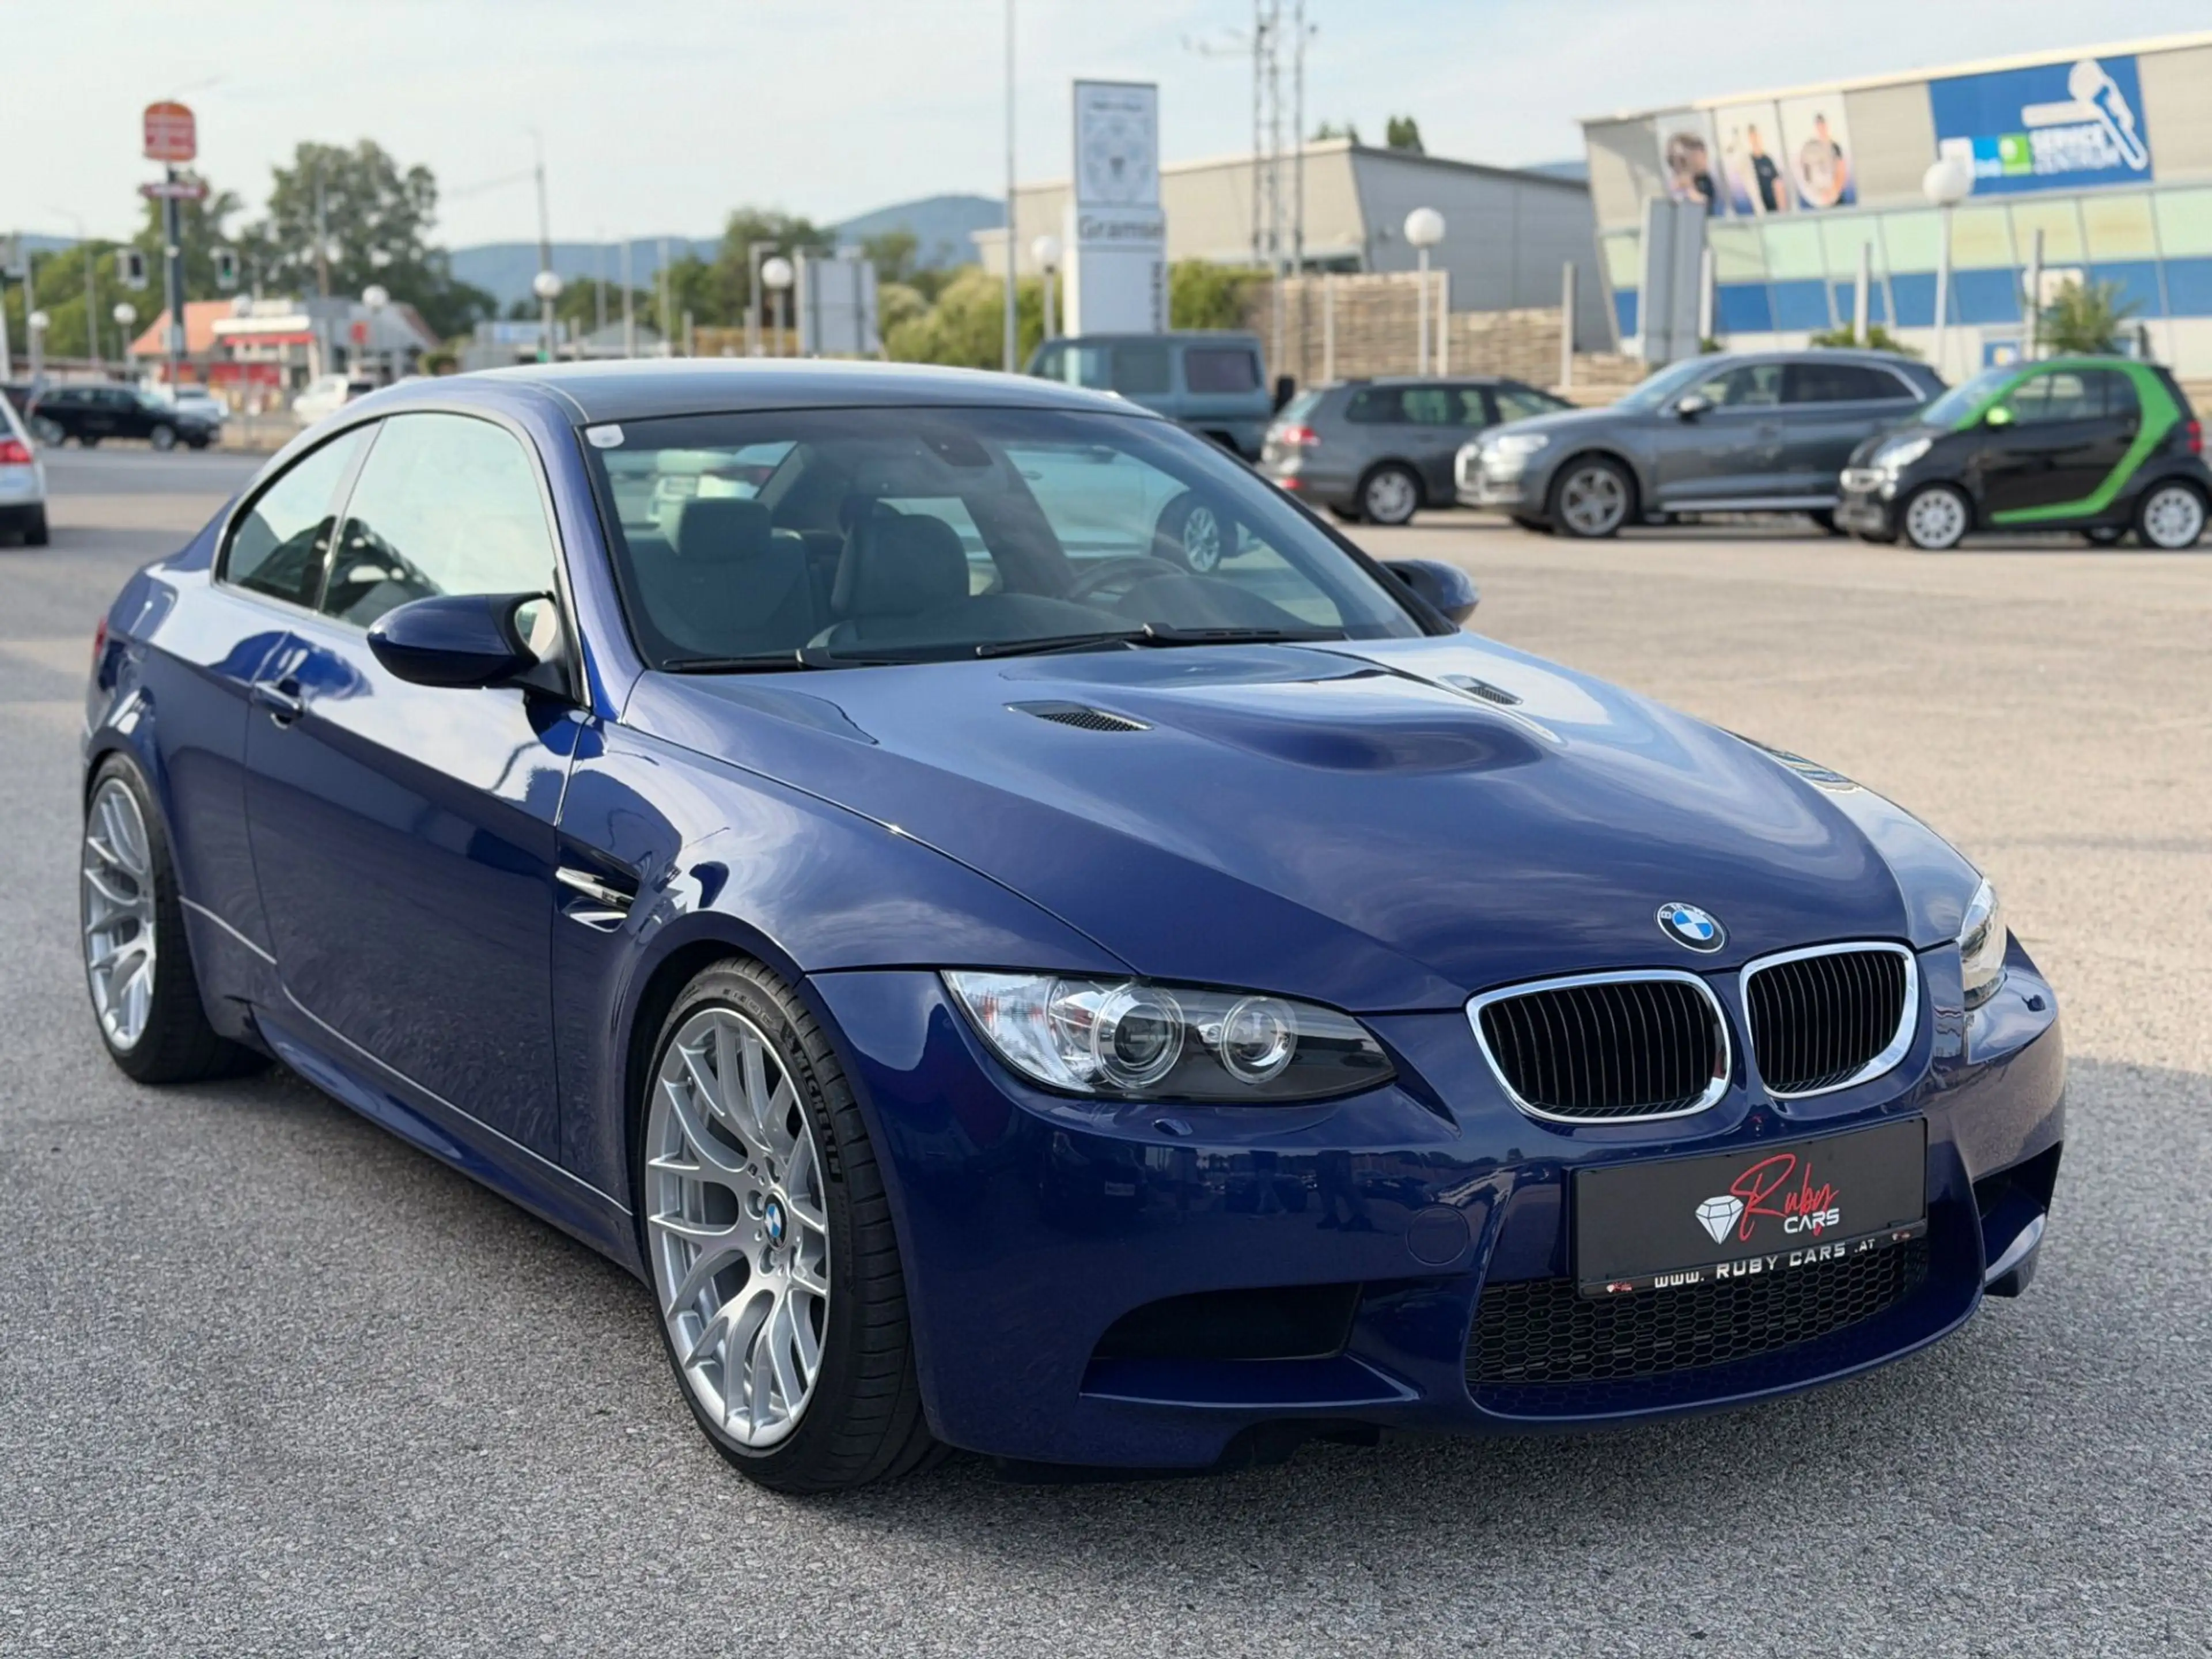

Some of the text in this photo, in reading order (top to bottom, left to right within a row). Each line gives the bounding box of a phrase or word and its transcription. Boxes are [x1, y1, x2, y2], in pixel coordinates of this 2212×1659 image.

[791, 1048, 843, 1180] MICHELIN
[1730, 1153, 1840, 1241] Ruby
[1783, 1208, 1839, 1234] CARS
[1716, 1255, 1778, 1279] RUBY
[1789, 1242, 1846, 1267] CARS
